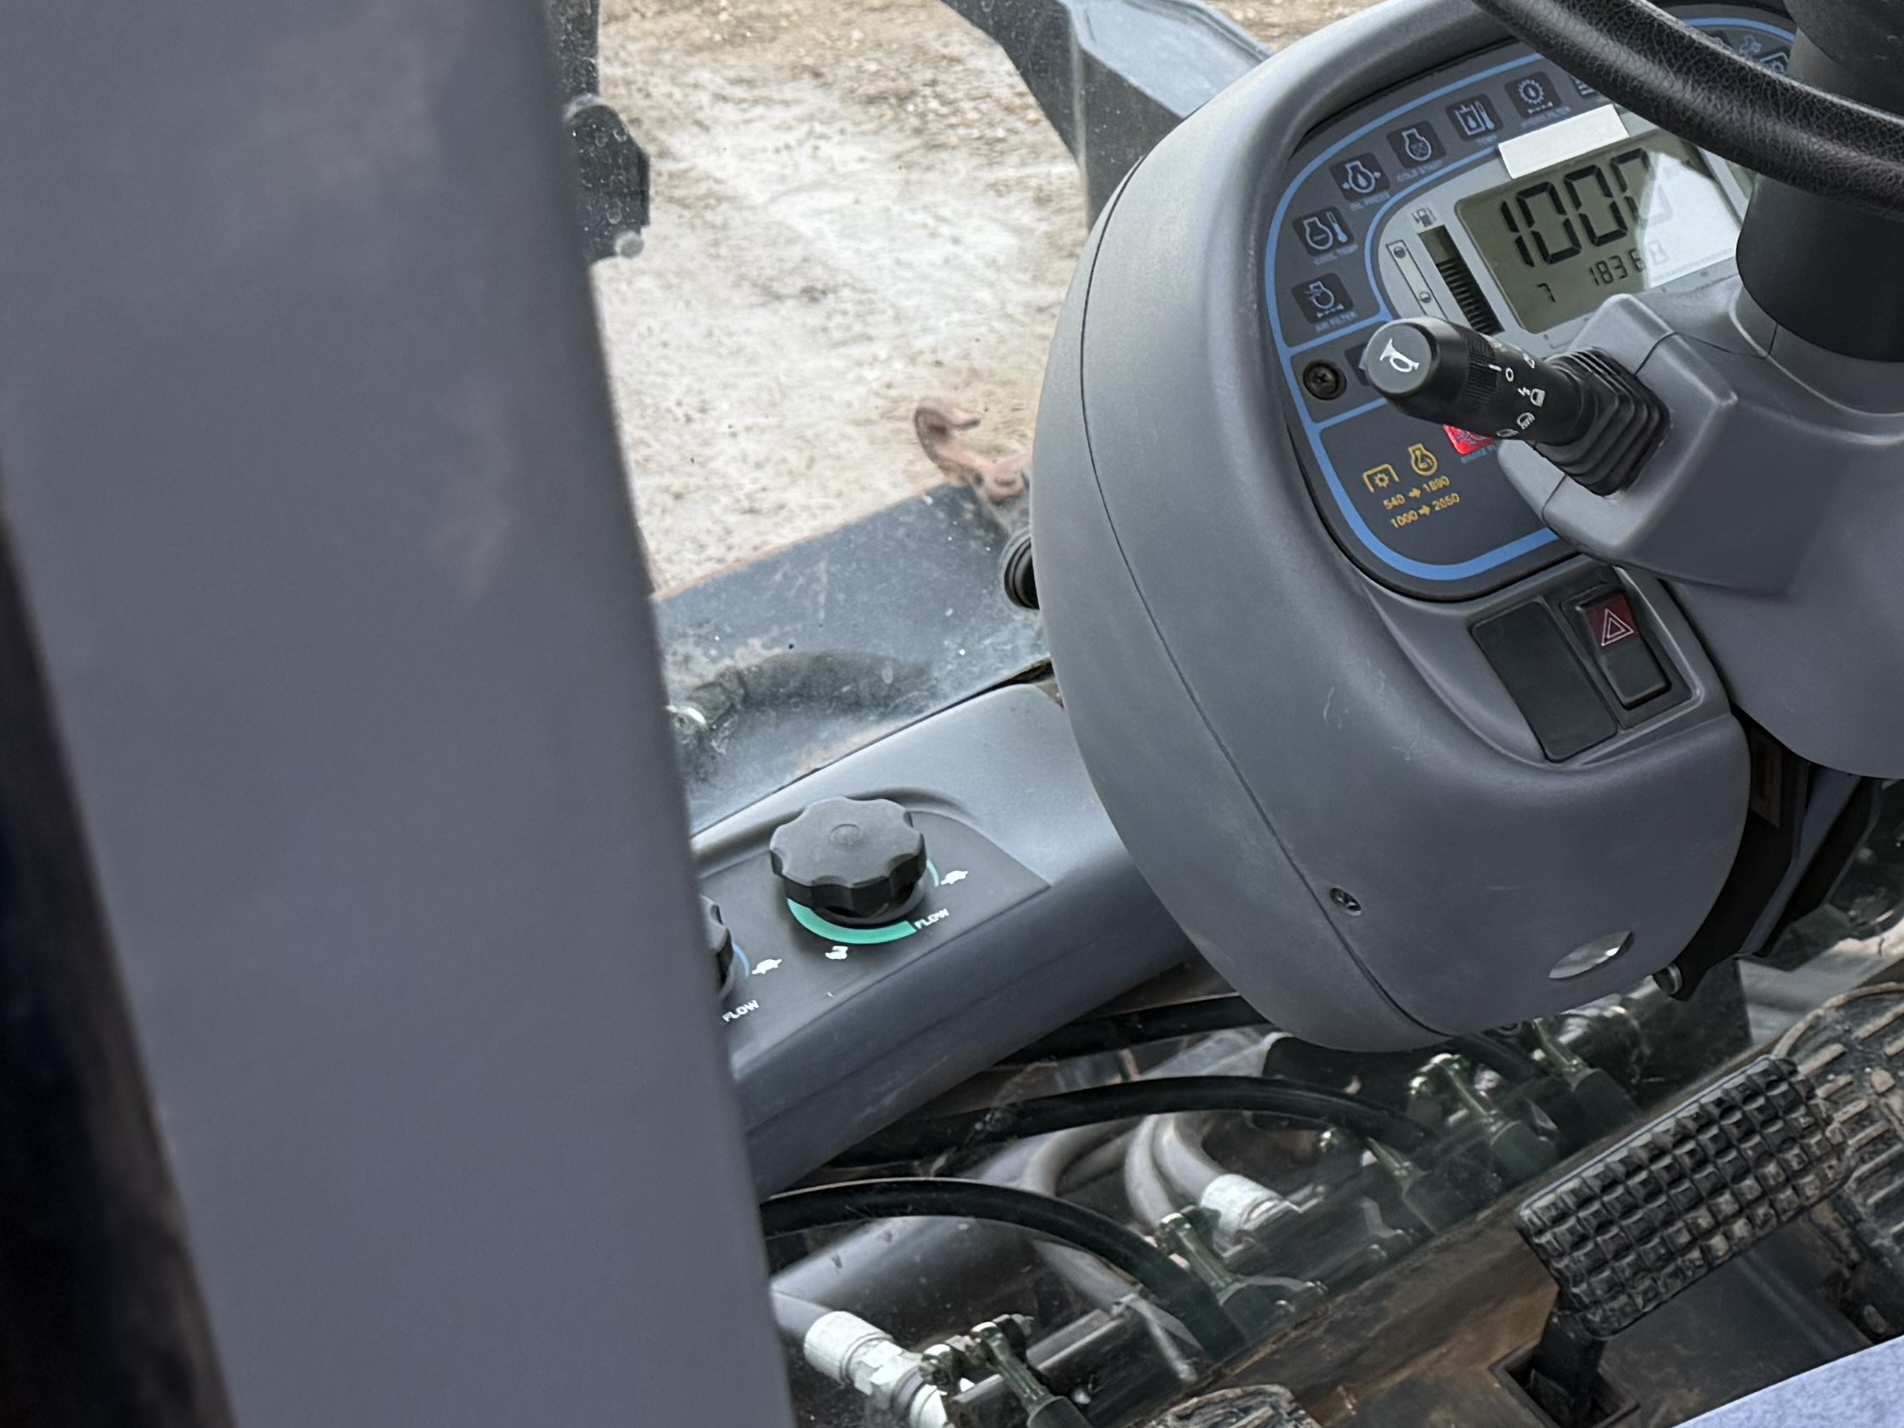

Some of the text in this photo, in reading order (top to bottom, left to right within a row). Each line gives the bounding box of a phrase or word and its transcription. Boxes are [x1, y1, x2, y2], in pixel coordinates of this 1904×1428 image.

[1501, 148, 1673, 267] 1000
[1383, 494, 1406, 510] 540
[1390, 493, 1460, 529] 1000 2050
[914, 908, 949, 930] FLOW
[722, 999, 760, 1022] FLOW
